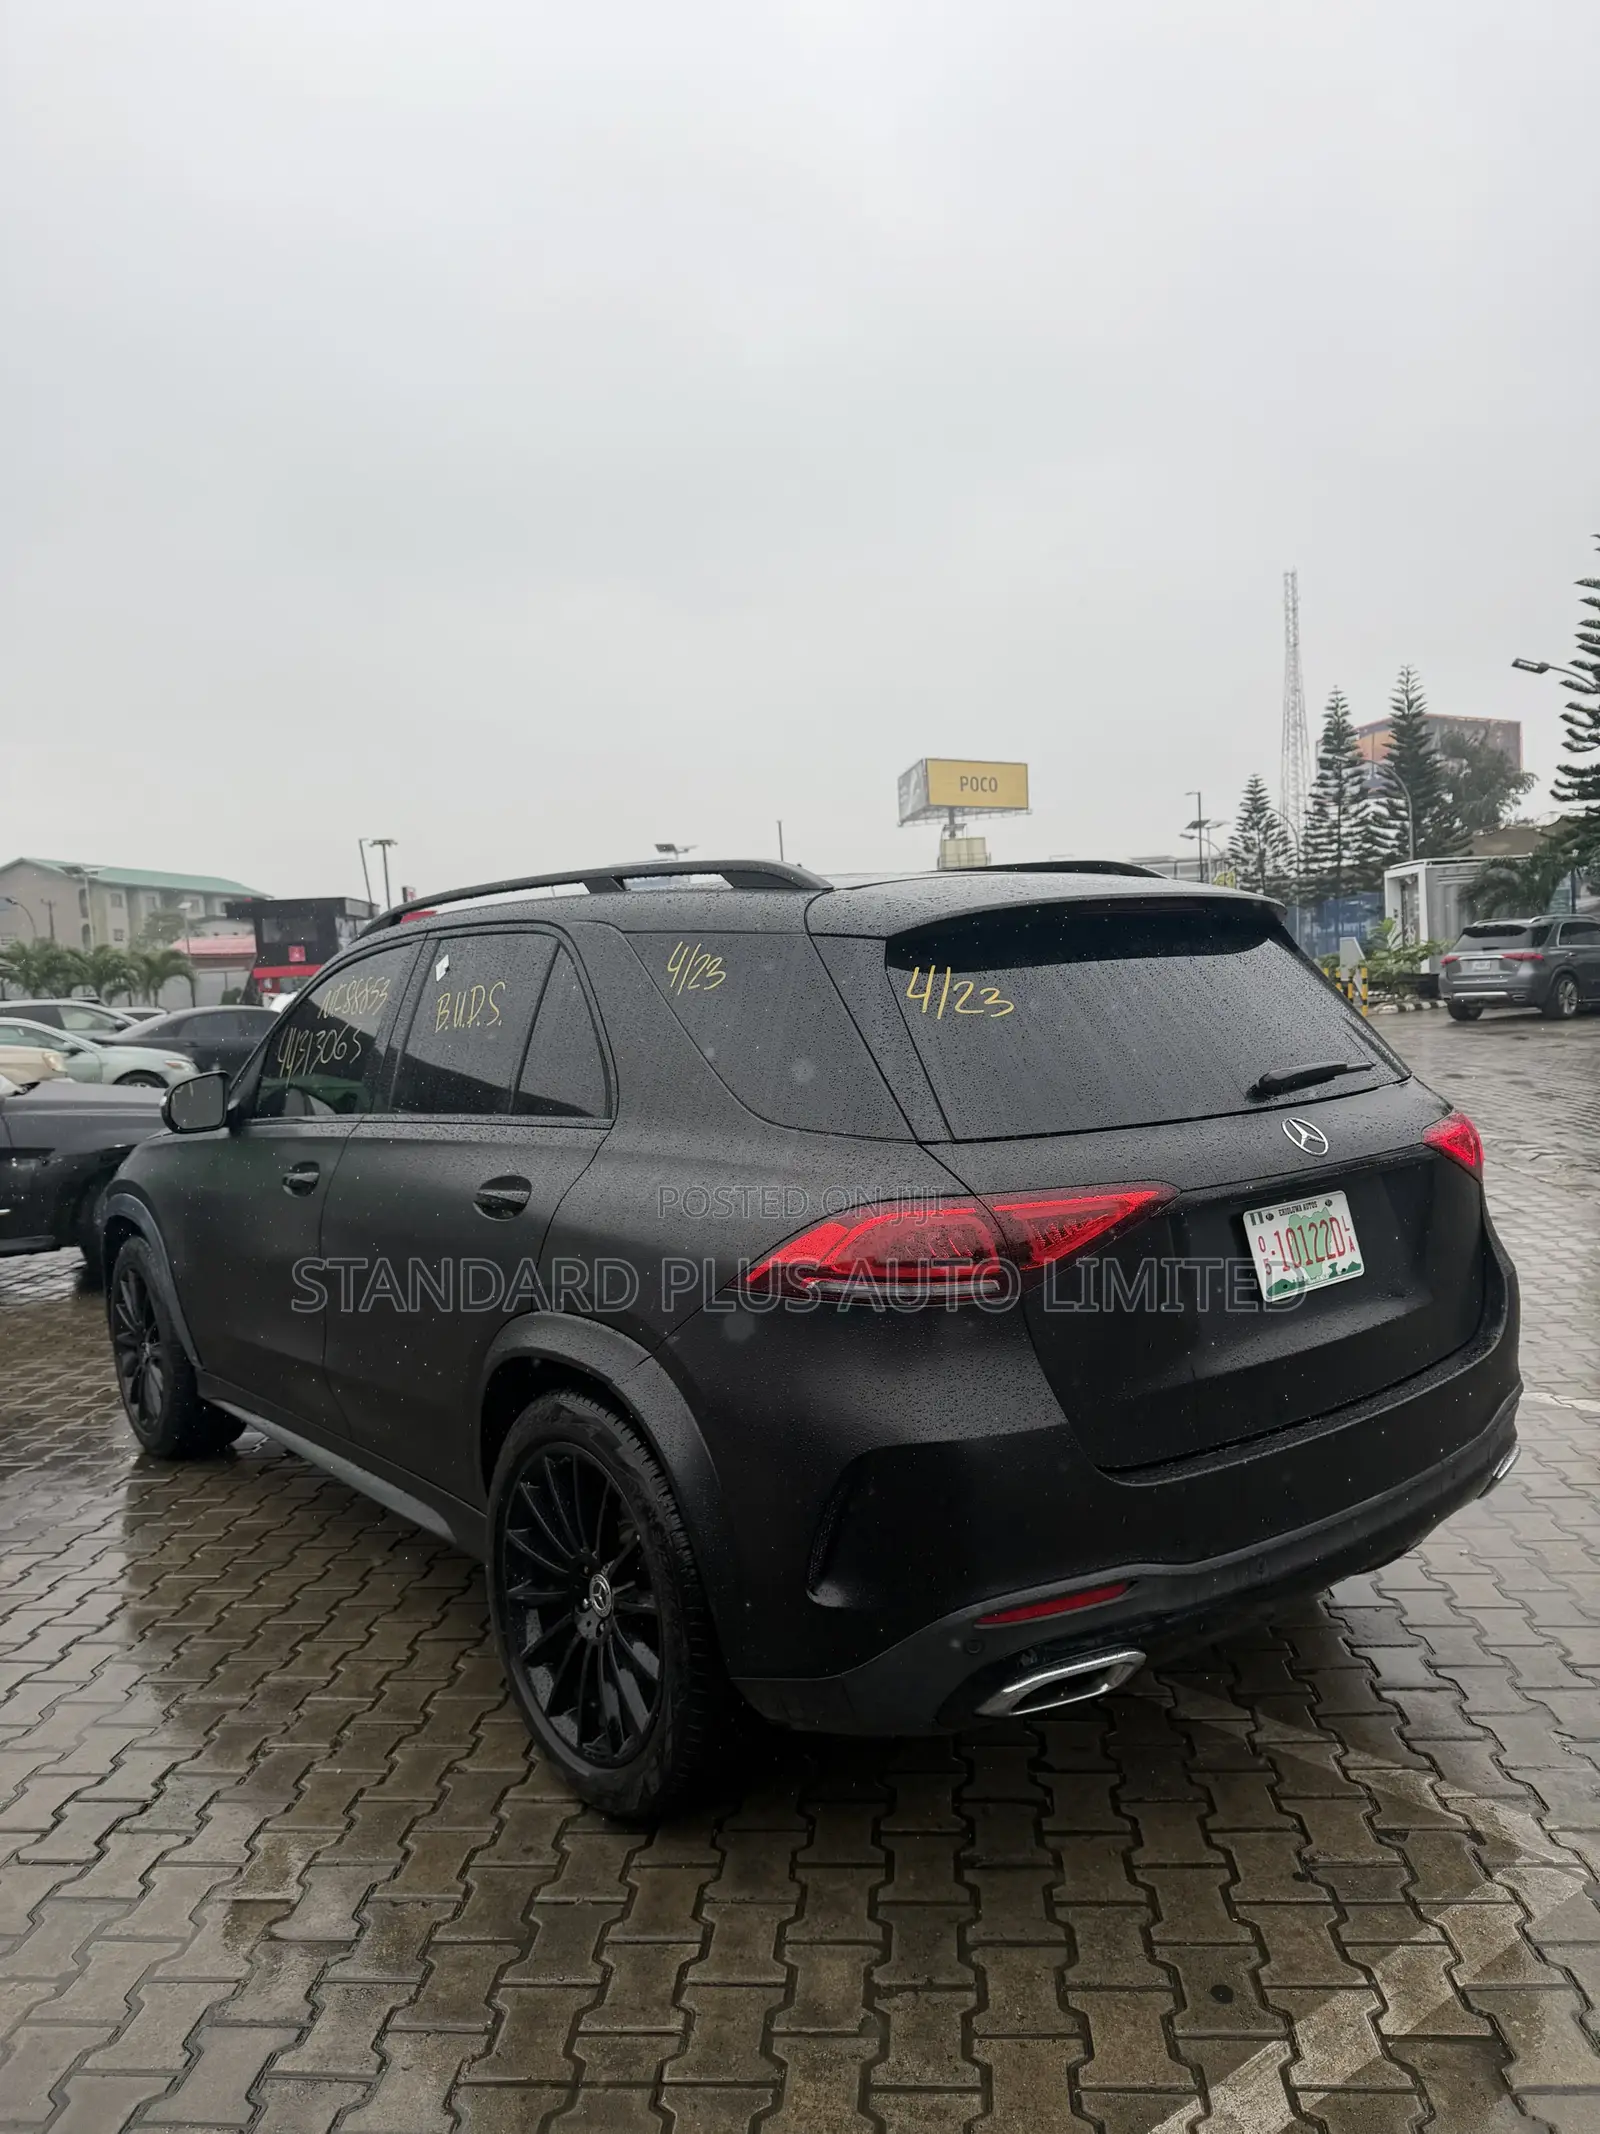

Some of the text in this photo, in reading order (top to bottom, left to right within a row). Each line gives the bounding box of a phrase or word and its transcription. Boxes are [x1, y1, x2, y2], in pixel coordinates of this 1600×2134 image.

[959, 775, 998, 793] POCO
[667, 941, 727, 995] 4/23
[906, 965, 1014, 1019] 4/23
